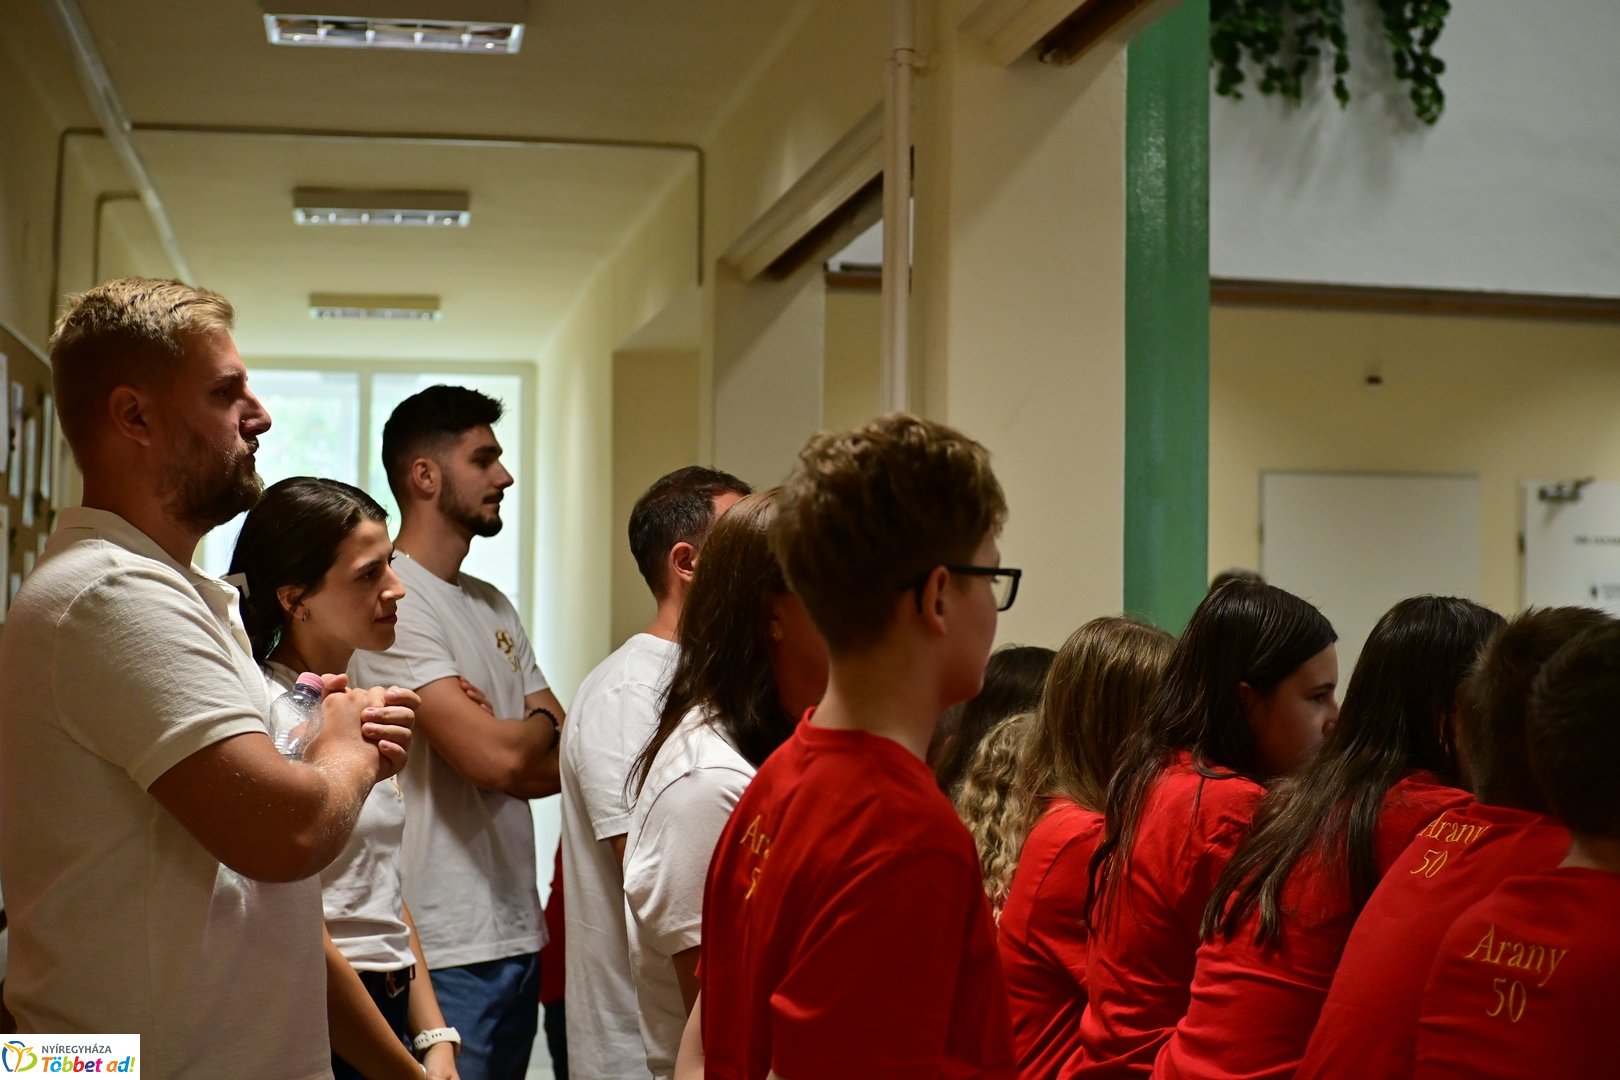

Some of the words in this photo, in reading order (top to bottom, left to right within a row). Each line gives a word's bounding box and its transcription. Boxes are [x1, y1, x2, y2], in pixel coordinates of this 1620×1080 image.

[1410, 849, 1448, 878] 50
[1464, 923, 1569, 987] Arany
[1486, 978, 1526, 1023] 50
